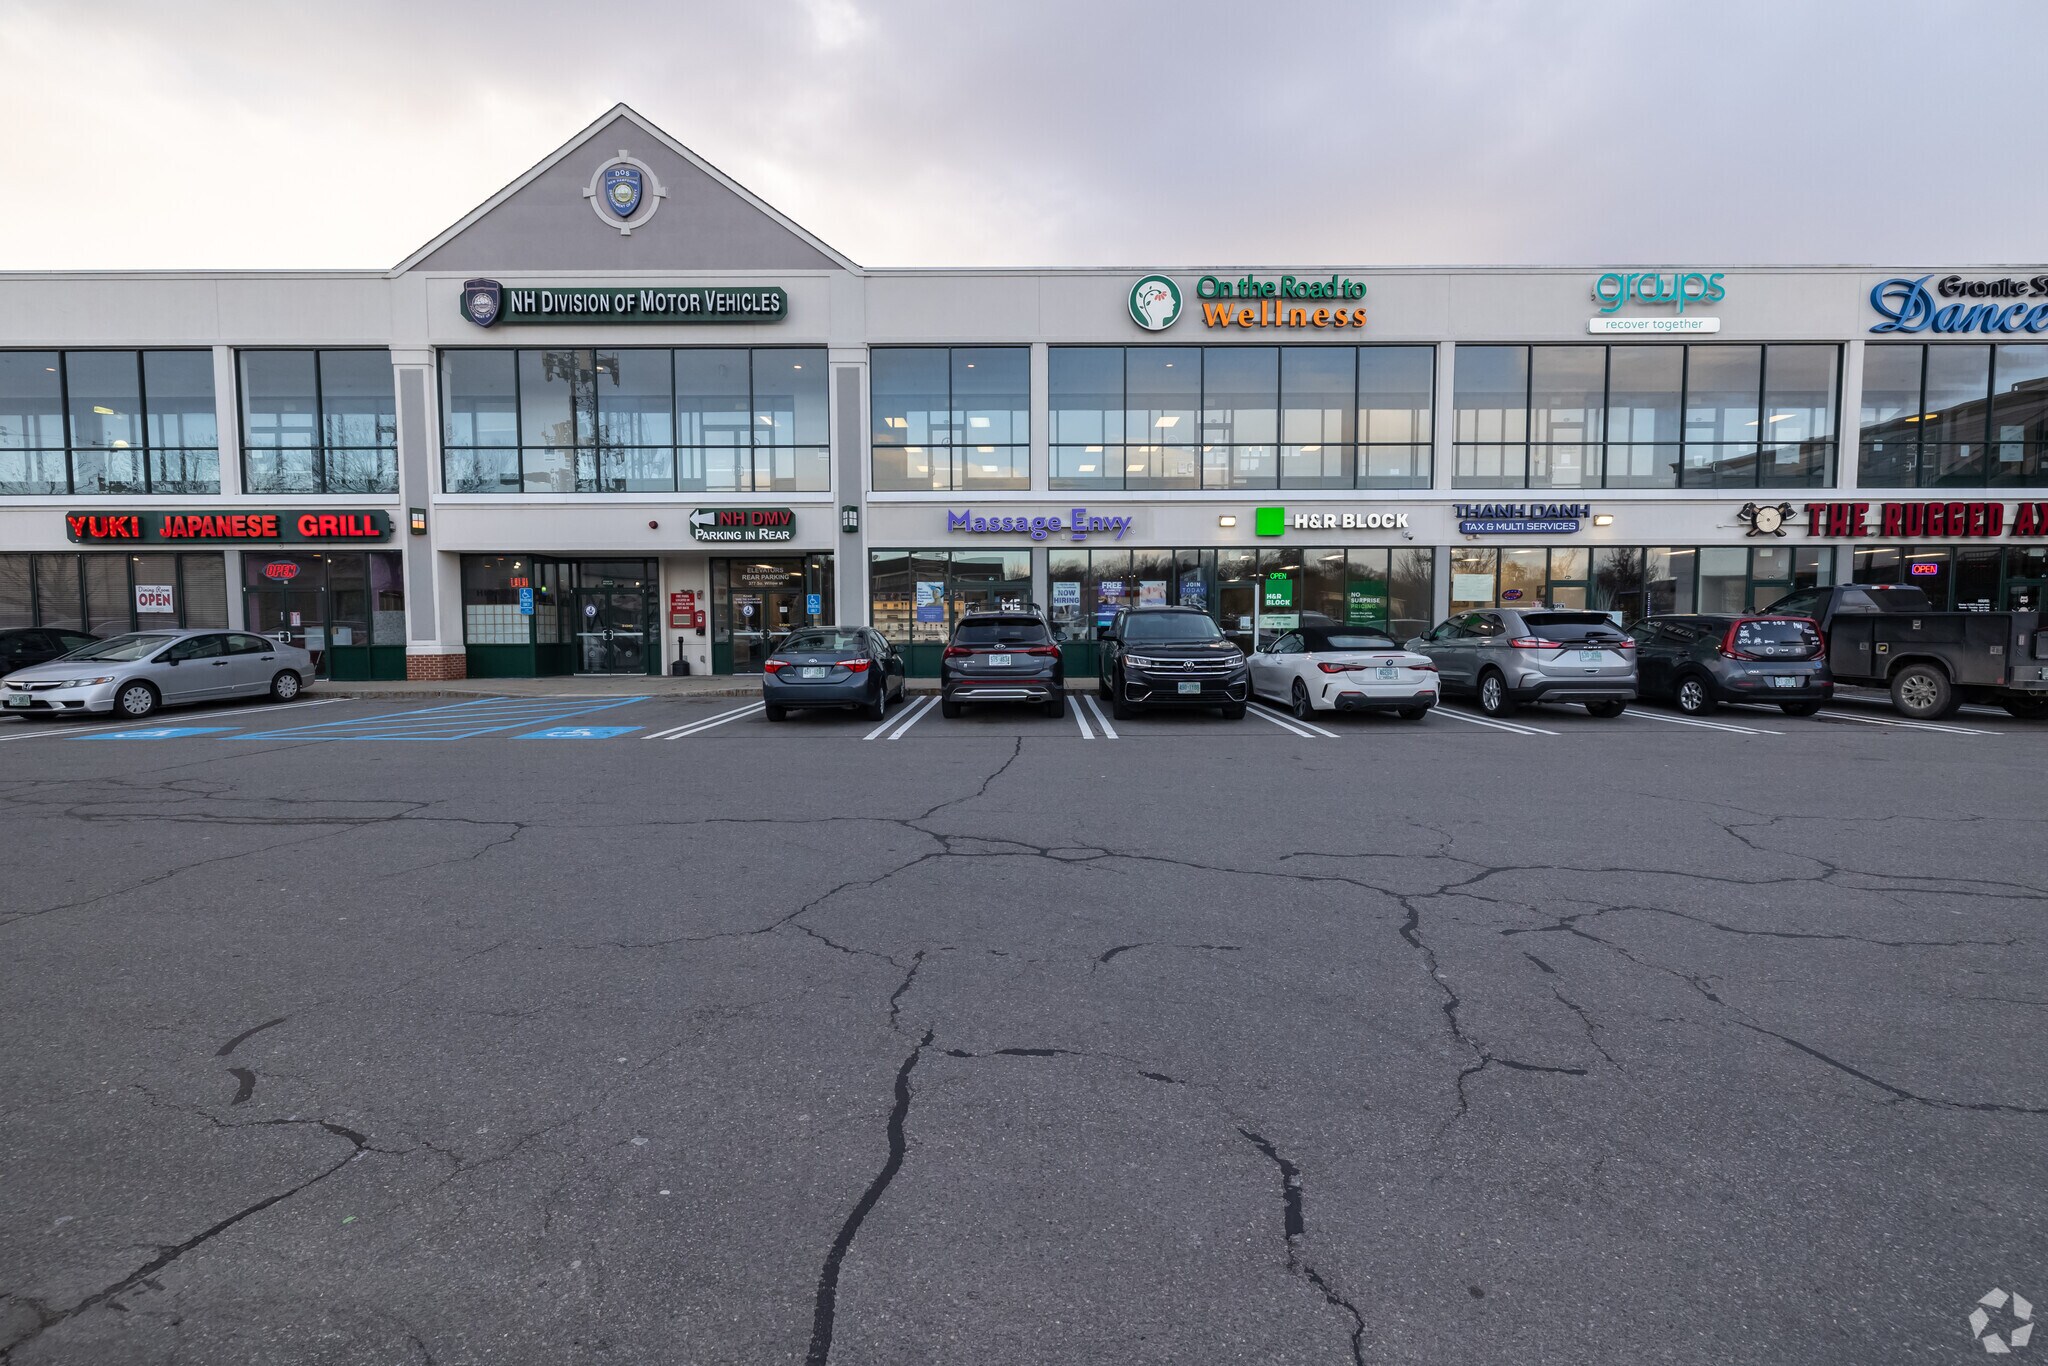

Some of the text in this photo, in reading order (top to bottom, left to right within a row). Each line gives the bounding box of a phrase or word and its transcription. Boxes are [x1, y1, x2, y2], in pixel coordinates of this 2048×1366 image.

[615, 169, 630, 177] DOS
[1197, 274, 1367, 299] On the Road to
[1596, 272, 1726, 314] groups
[1938, 274, 2029, 297] Granite
[511, 290, 536, 312] NH
[541, 290, 610, 312] DIVISION
[614, 293, 635, 312] OF
[640, 289, 700, 312] MOTOR
[704, 289, 780, 312] VEHICLES
[1202, 300, 1367, 328] Wellness
[1605, 319, 1704, 331] recover together
[720, 511, 791, 526] NH DMV
[1454, 503, 1591, 519] THANH DANH
[67, 514, 380, 538] YUKI JAPANESE GRILL
[947, 508, 1133, 541] Massage Envy
[1294, 513, 1409, 529] H&R BLOCK
[1465, 522, 1576, 531] TAX & MULTI SERVICES
[1804, 502, 1869, 537] THE
[1879, 502, 2004, 537] RUGGED
[695, 528, 790, 540] PARKING IN REAR
[265, 563, 297, 578] OPEN
[1913, 565, 1936, 573] OPEN
[1101, 581, 1122, 589] FREE
[138, 593, 171, 607] OPEN
[1057, 589, 1076, 597] NOW
